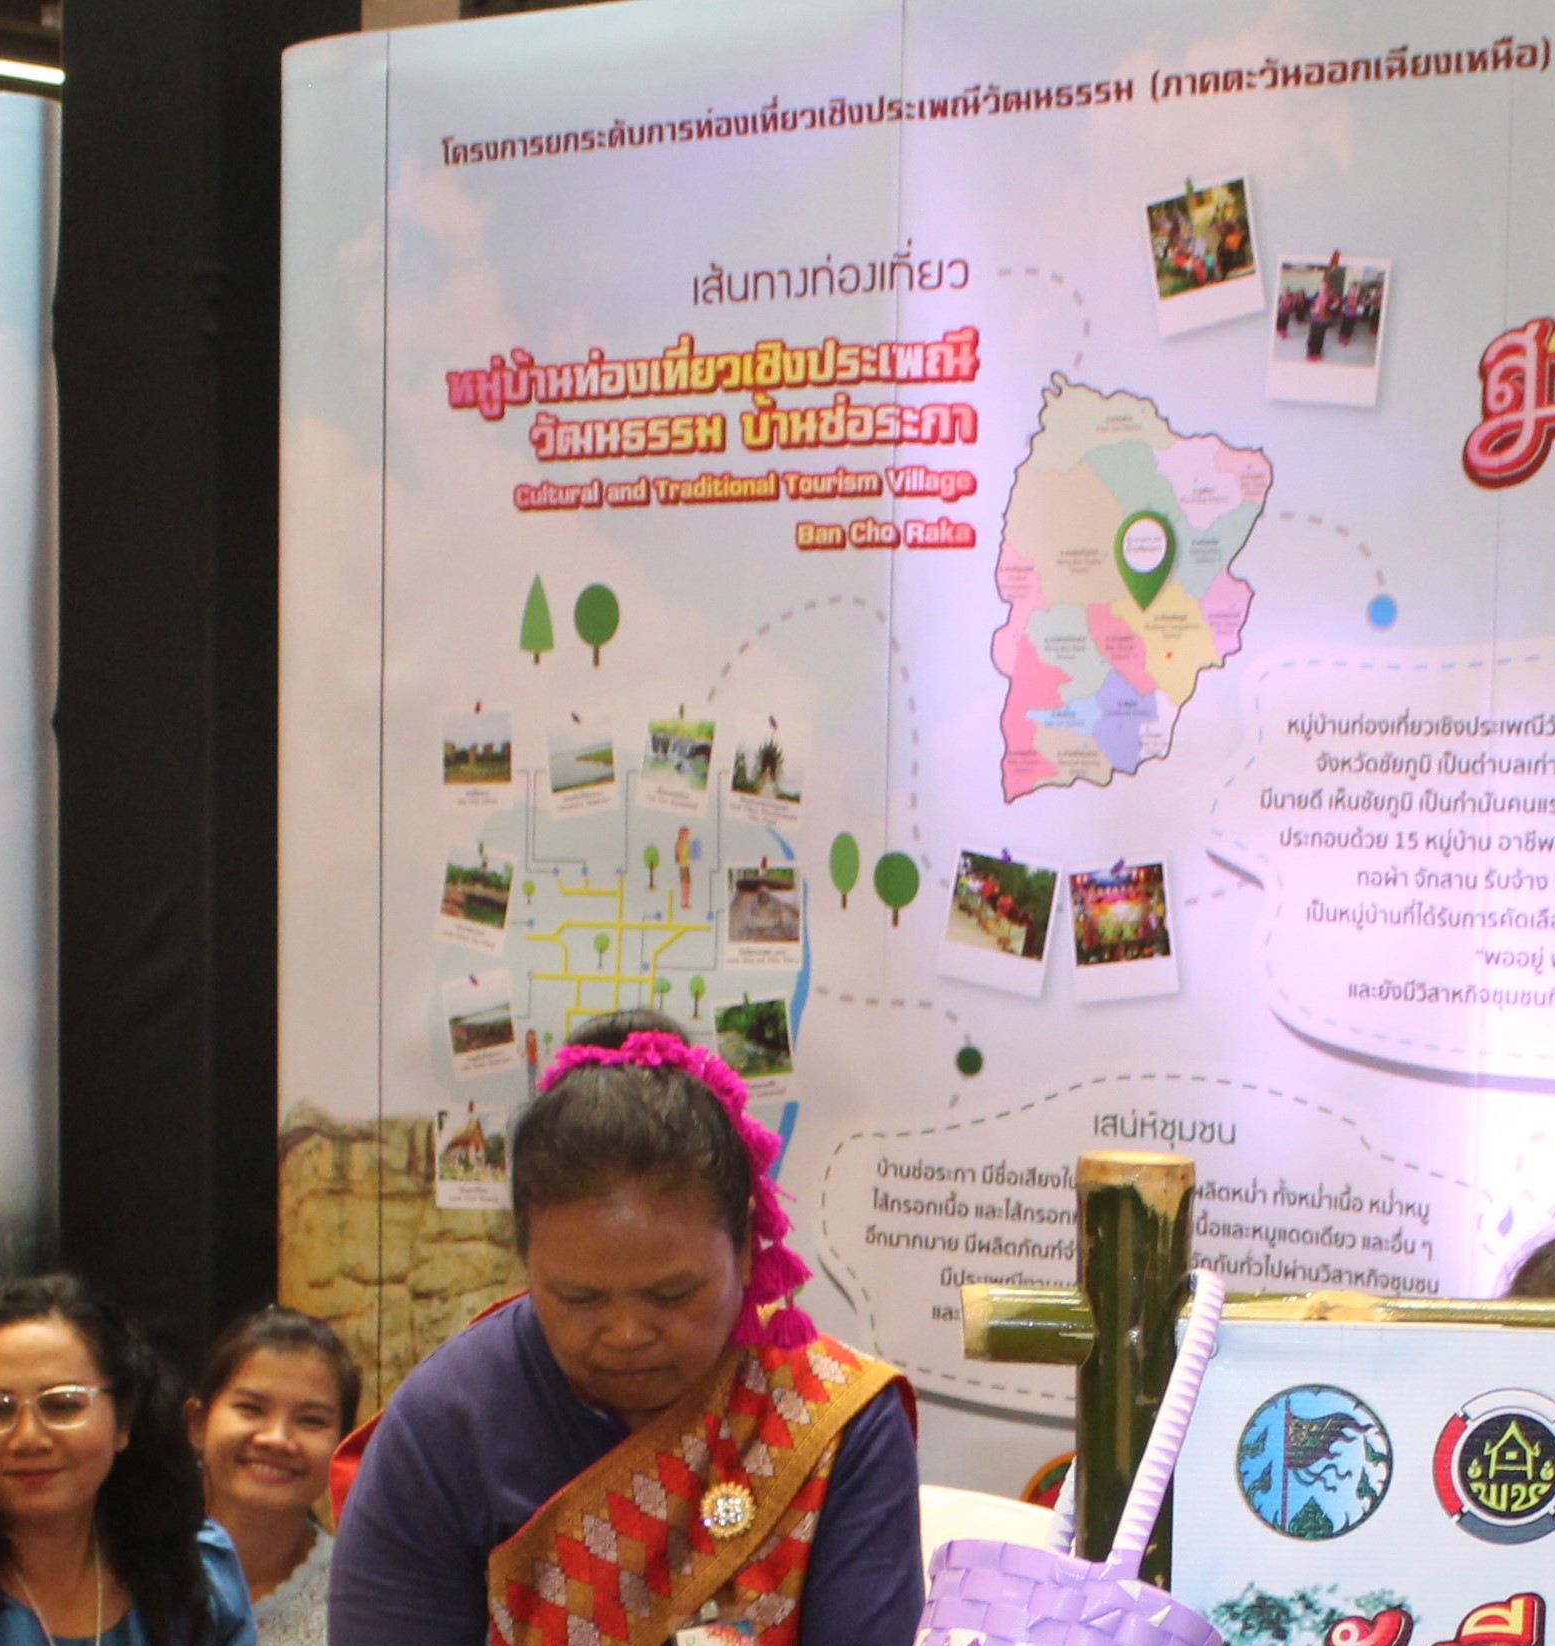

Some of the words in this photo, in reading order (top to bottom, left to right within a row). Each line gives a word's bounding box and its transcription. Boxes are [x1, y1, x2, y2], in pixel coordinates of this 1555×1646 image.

[1150, 36, 1552, 103] (ภาคตะวันออกเฉียงเหนือ)
[693, 237, 970, 306] เส้นทางท่องเที่ยว
[446, 325, 980, 419] หมู่บ้านท่องเที่ยวเชิงประเพณี
[529, 411, 726, 462] วัฒนธรรม
[741, 388, 979, 451] บ้านช่อระกา
[513, 477, 604, 511] Cultural
[604, 475, 652, 508] and
[650, 471, 779, 506] Traditional
[781, 467, 882, 499] Tourism
[885, 463, 978, 497] Village
[795, 520, 846, 550] Ban
[849, 518, 901, 549] Cho
[903, 518, 977, 549] Raka
[1316, 753, 1432, 781] จังหวัดชัยภูมิ
[1280, 826, 1388, 851] ประกอบด้วย
[1394, 831, 1419, 851] 15
[1425, 830, 1491, 858] หมู่บ้าน
[1414, 867, 1477, 891] จักสาน
[1094, 1108, 1237, 1150] เสน่ห์ชุมชน
[877, 1157, 976, 1185] บ้านช่อระกา
[873, 1188, 969, 1219] ไส้กรอกเนื้อ
[864, 1224, 960, 1252] อีกมากมาย
